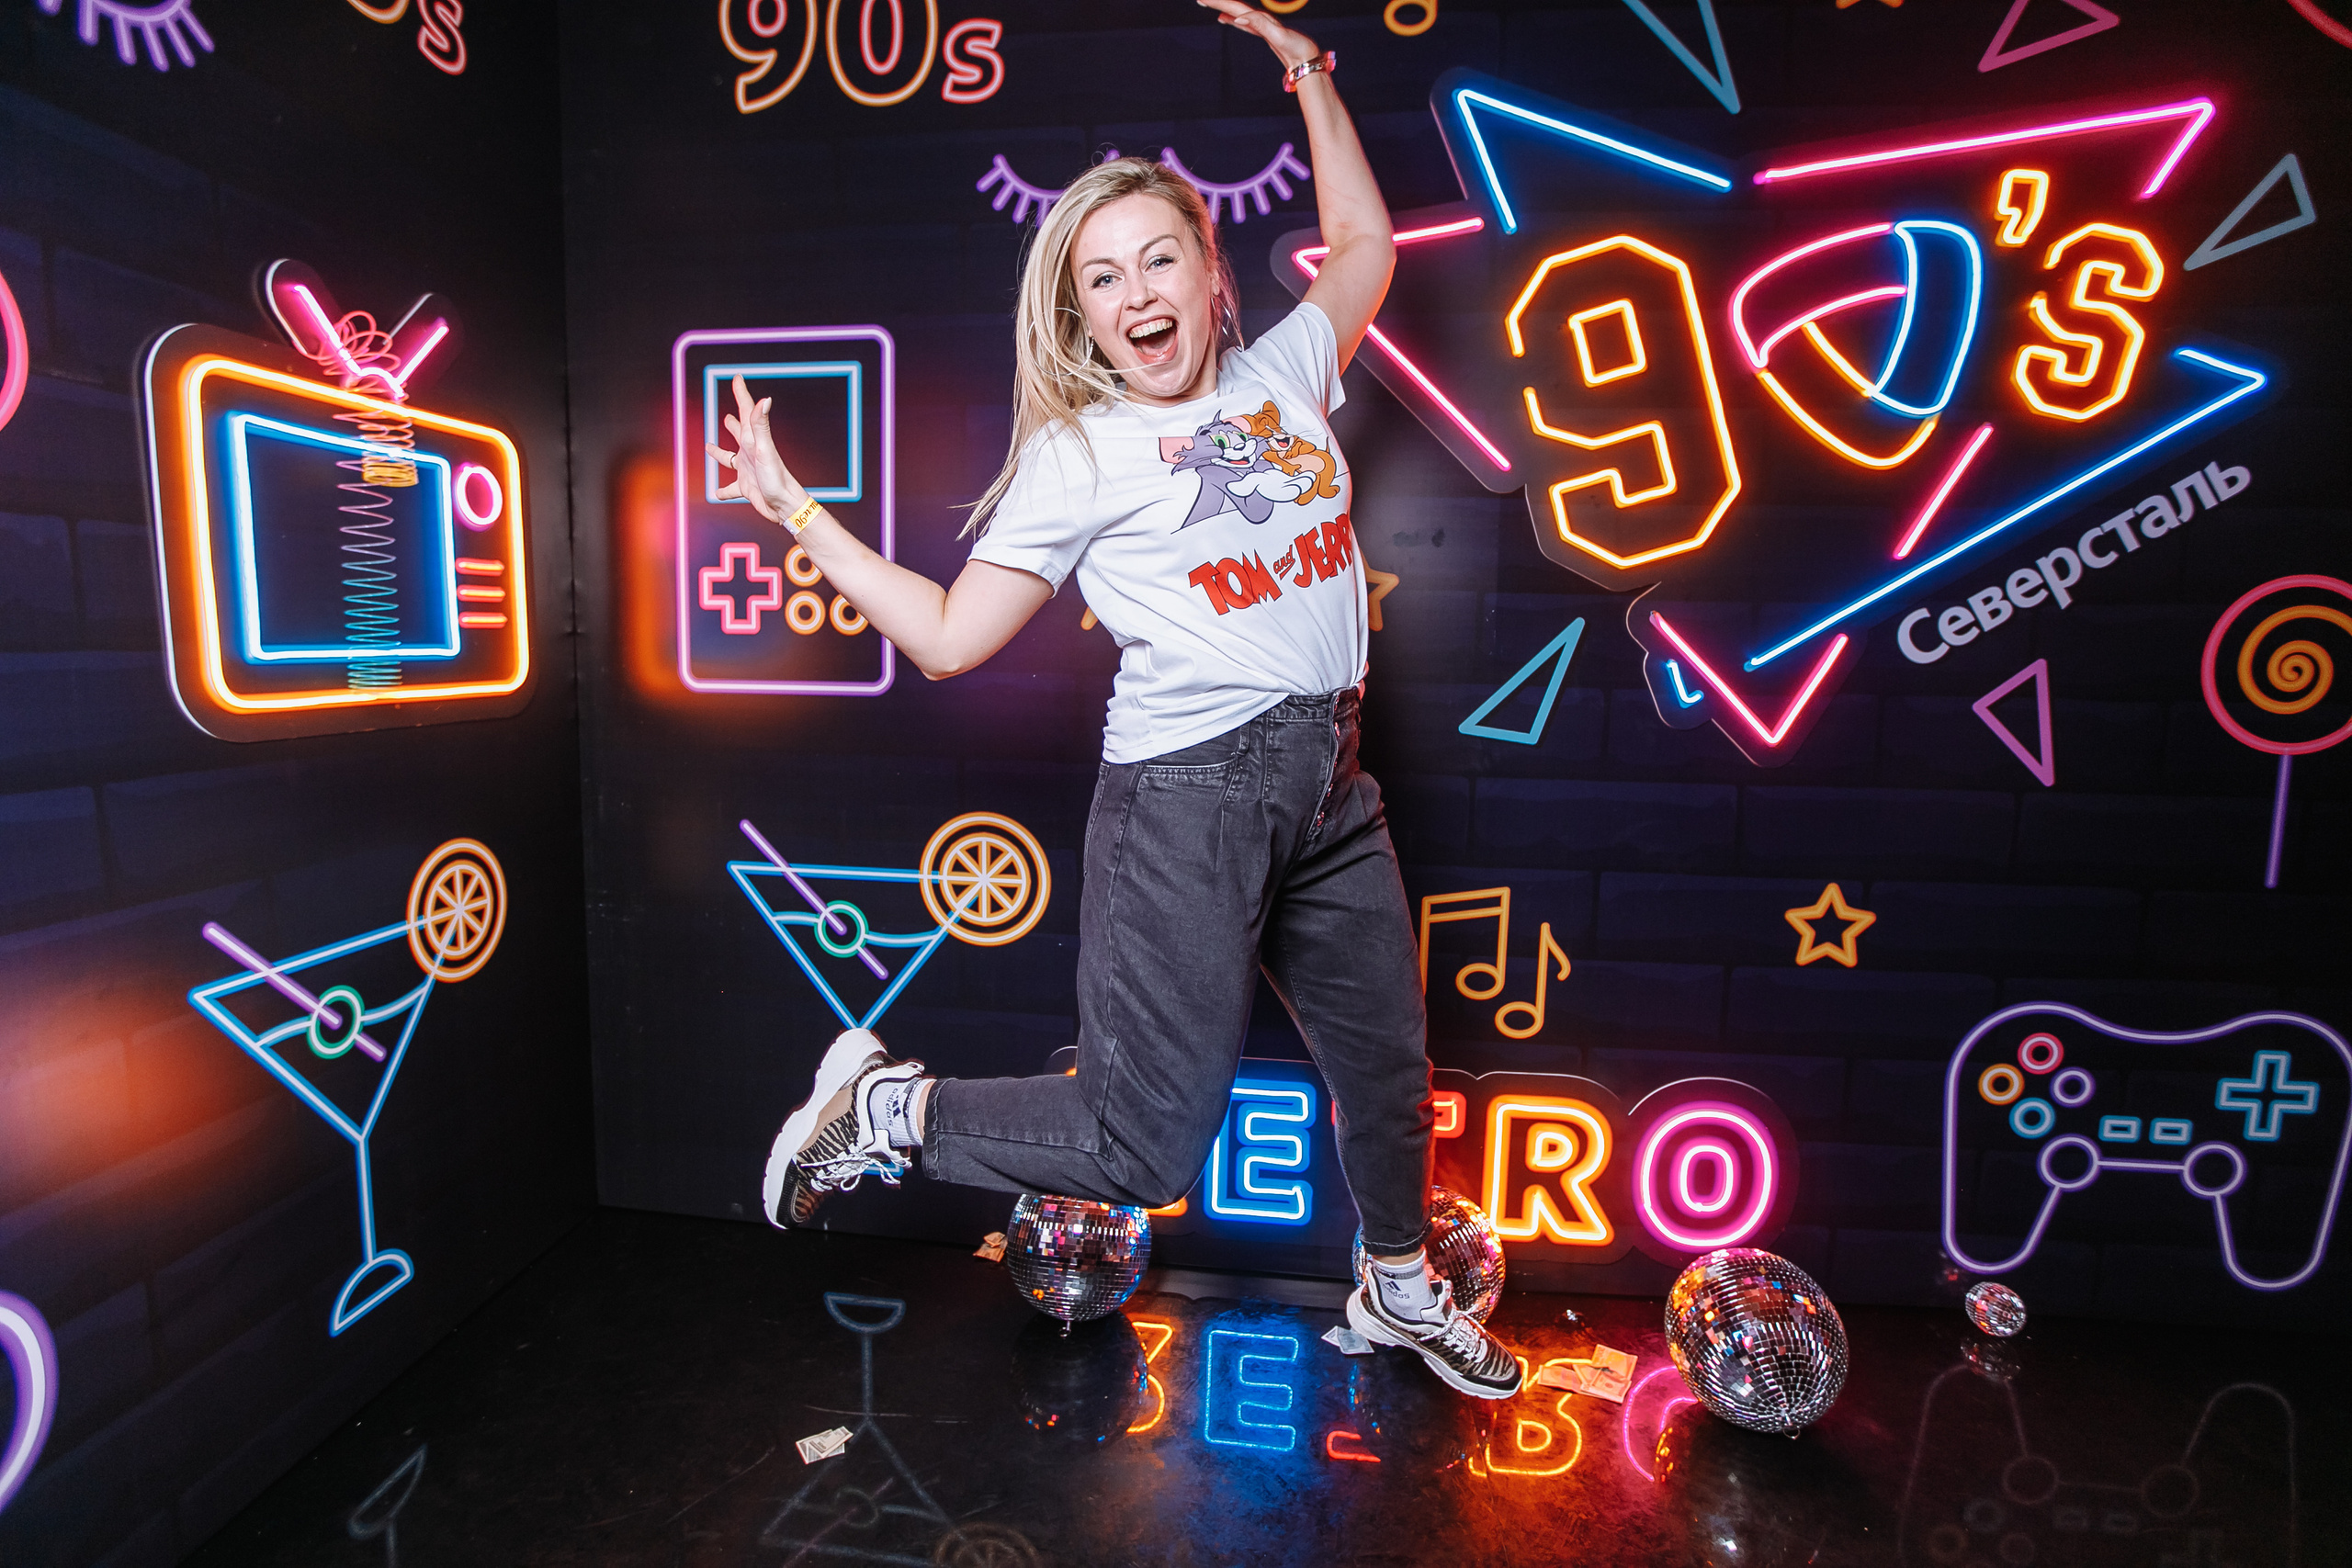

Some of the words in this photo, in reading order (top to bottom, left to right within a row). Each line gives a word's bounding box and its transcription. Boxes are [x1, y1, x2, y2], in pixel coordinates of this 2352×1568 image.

[718, 0, 1005, 114] 90s
[1188, 548, 1283, 615] TOM
[1272, 544, 1295, 581] and
[1293, 513, 1352, 588] JERR
[1896, 461, 2252, 664] Северсталь
[885, 1088, 899, 1126] adidas
[1066, 1067, 1781, 1252] ERO
